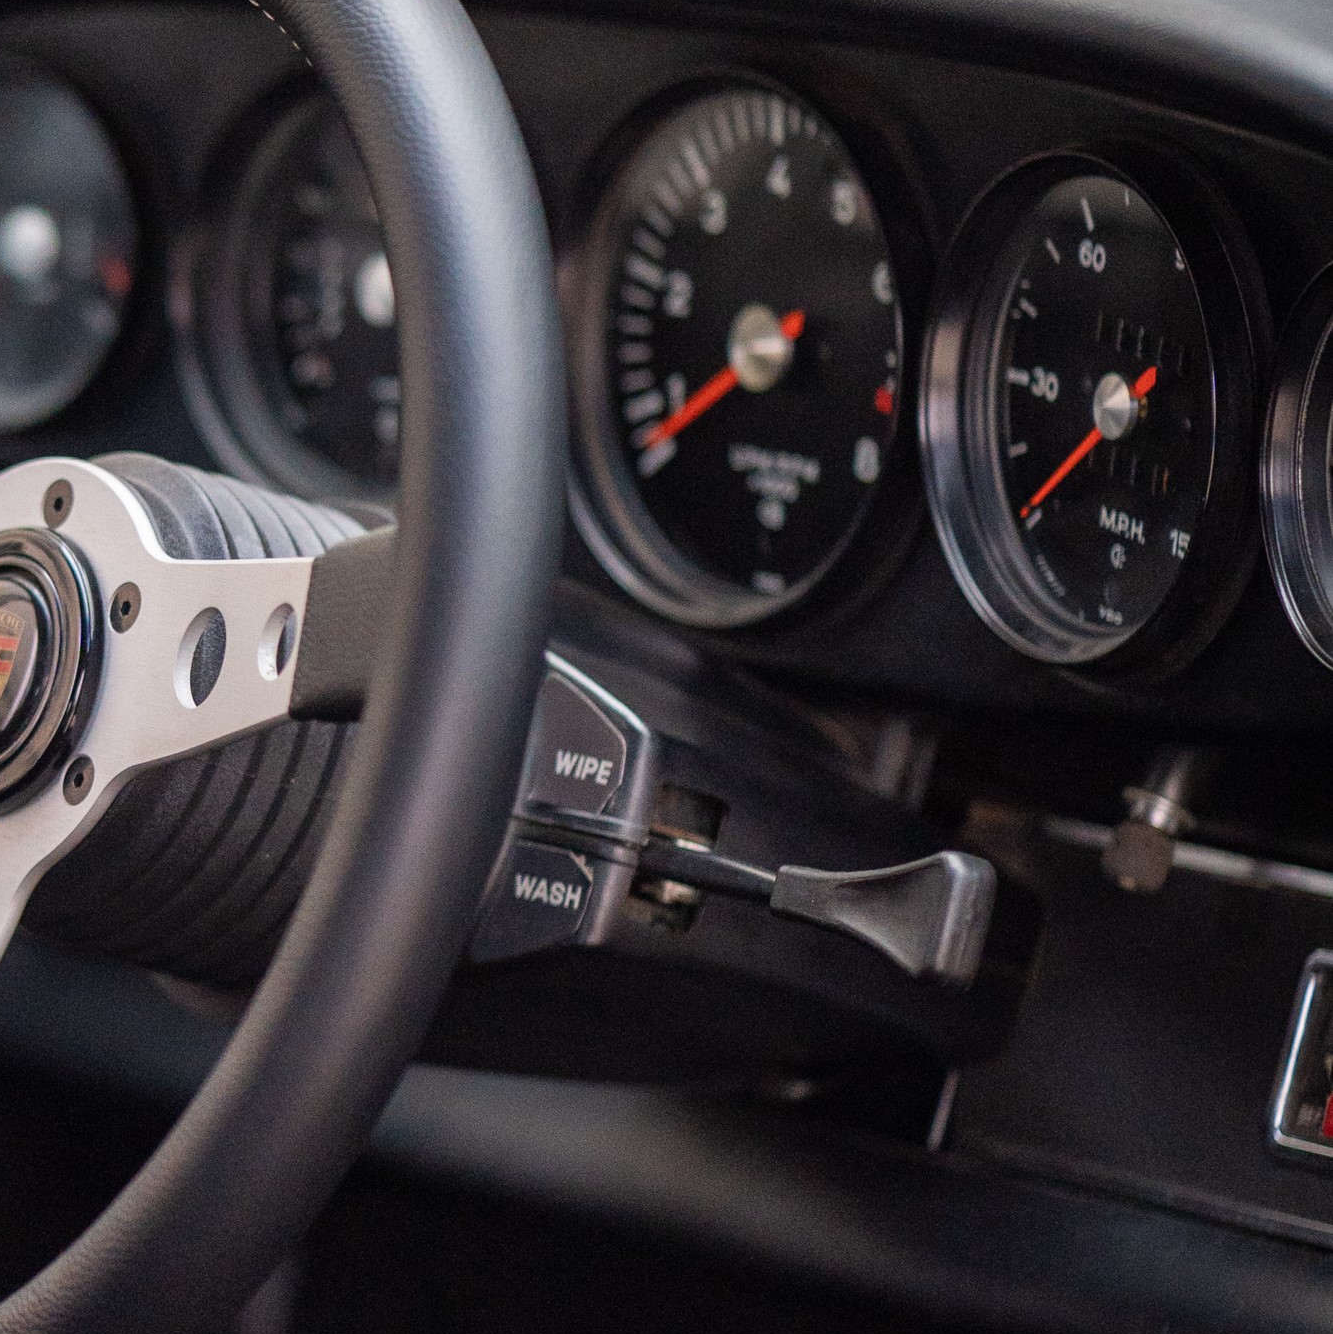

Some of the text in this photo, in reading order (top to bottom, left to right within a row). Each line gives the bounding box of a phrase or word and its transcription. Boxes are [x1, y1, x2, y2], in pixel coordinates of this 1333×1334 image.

[700, 187, 728, 236] 3
[1078, 238, 1106, 273] 60
[1031, 367, 1058, 402] 30
[1099, 504, 1145, 545] M.P.H.
[555, 749, 614, 786] WIPE
[515, 872, 583, 911] WASH
